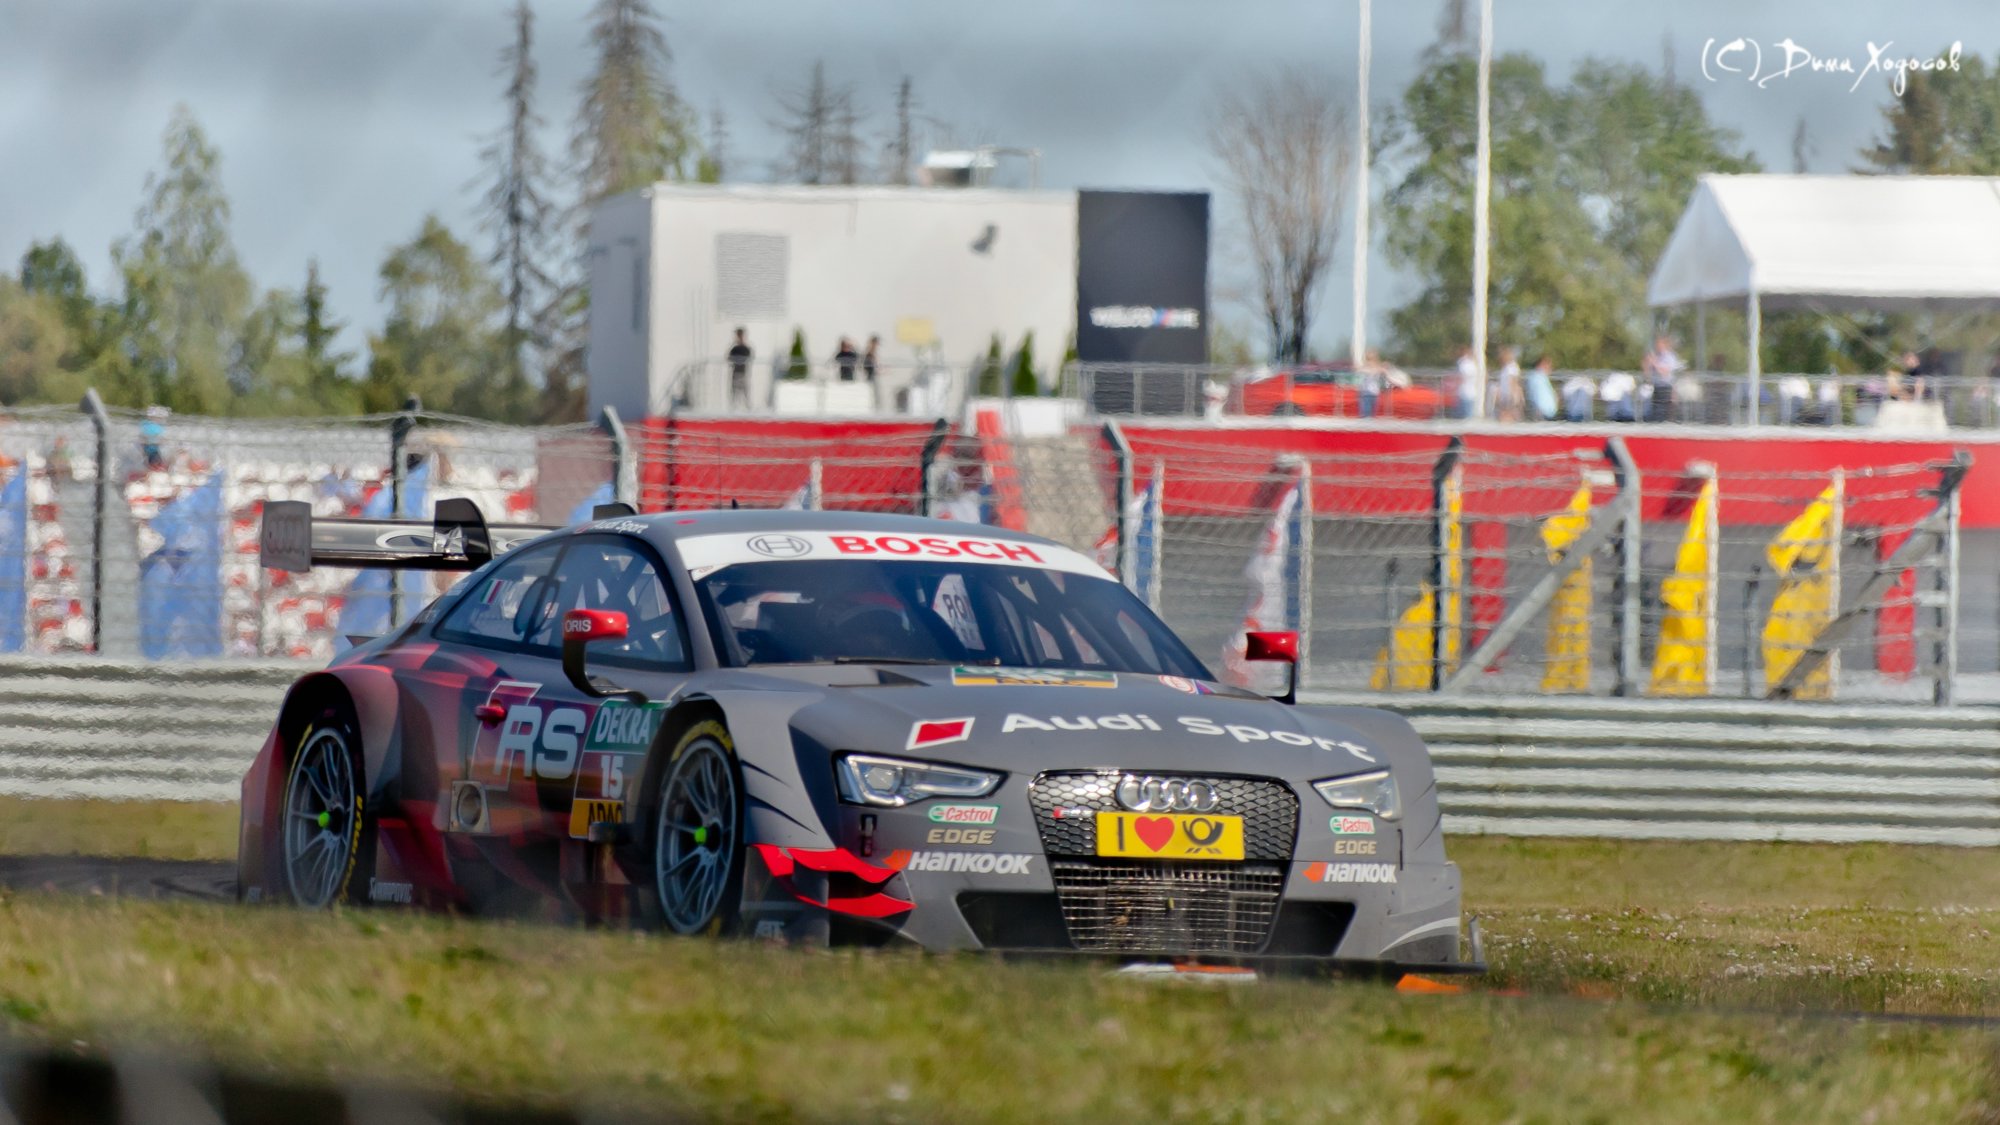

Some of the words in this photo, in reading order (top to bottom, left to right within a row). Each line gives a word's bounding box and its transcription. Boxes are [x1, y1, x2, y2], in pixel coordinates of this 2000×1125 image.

[828, 535, 1045, 564] BOSCH
[564, 619, 592, 632] ORIS
[595, 706, 652, 744] DEKRA
[493, 705, 587, 780] RS
[1002, 713, 1162, 733] Audi
[1178, 716, 1376, 763] Sport
[600, 755, 623, 799] 15
[588, 803, 623, 823] ADAC
[944, 807, 994, 822] Castrol
[927, 829, 996, 845] EDGE
[1117, 816, 1125, 852] I
[1343, 818, 1374, 833] Castrol
[1335, 840, 1377, 855] EDGE
